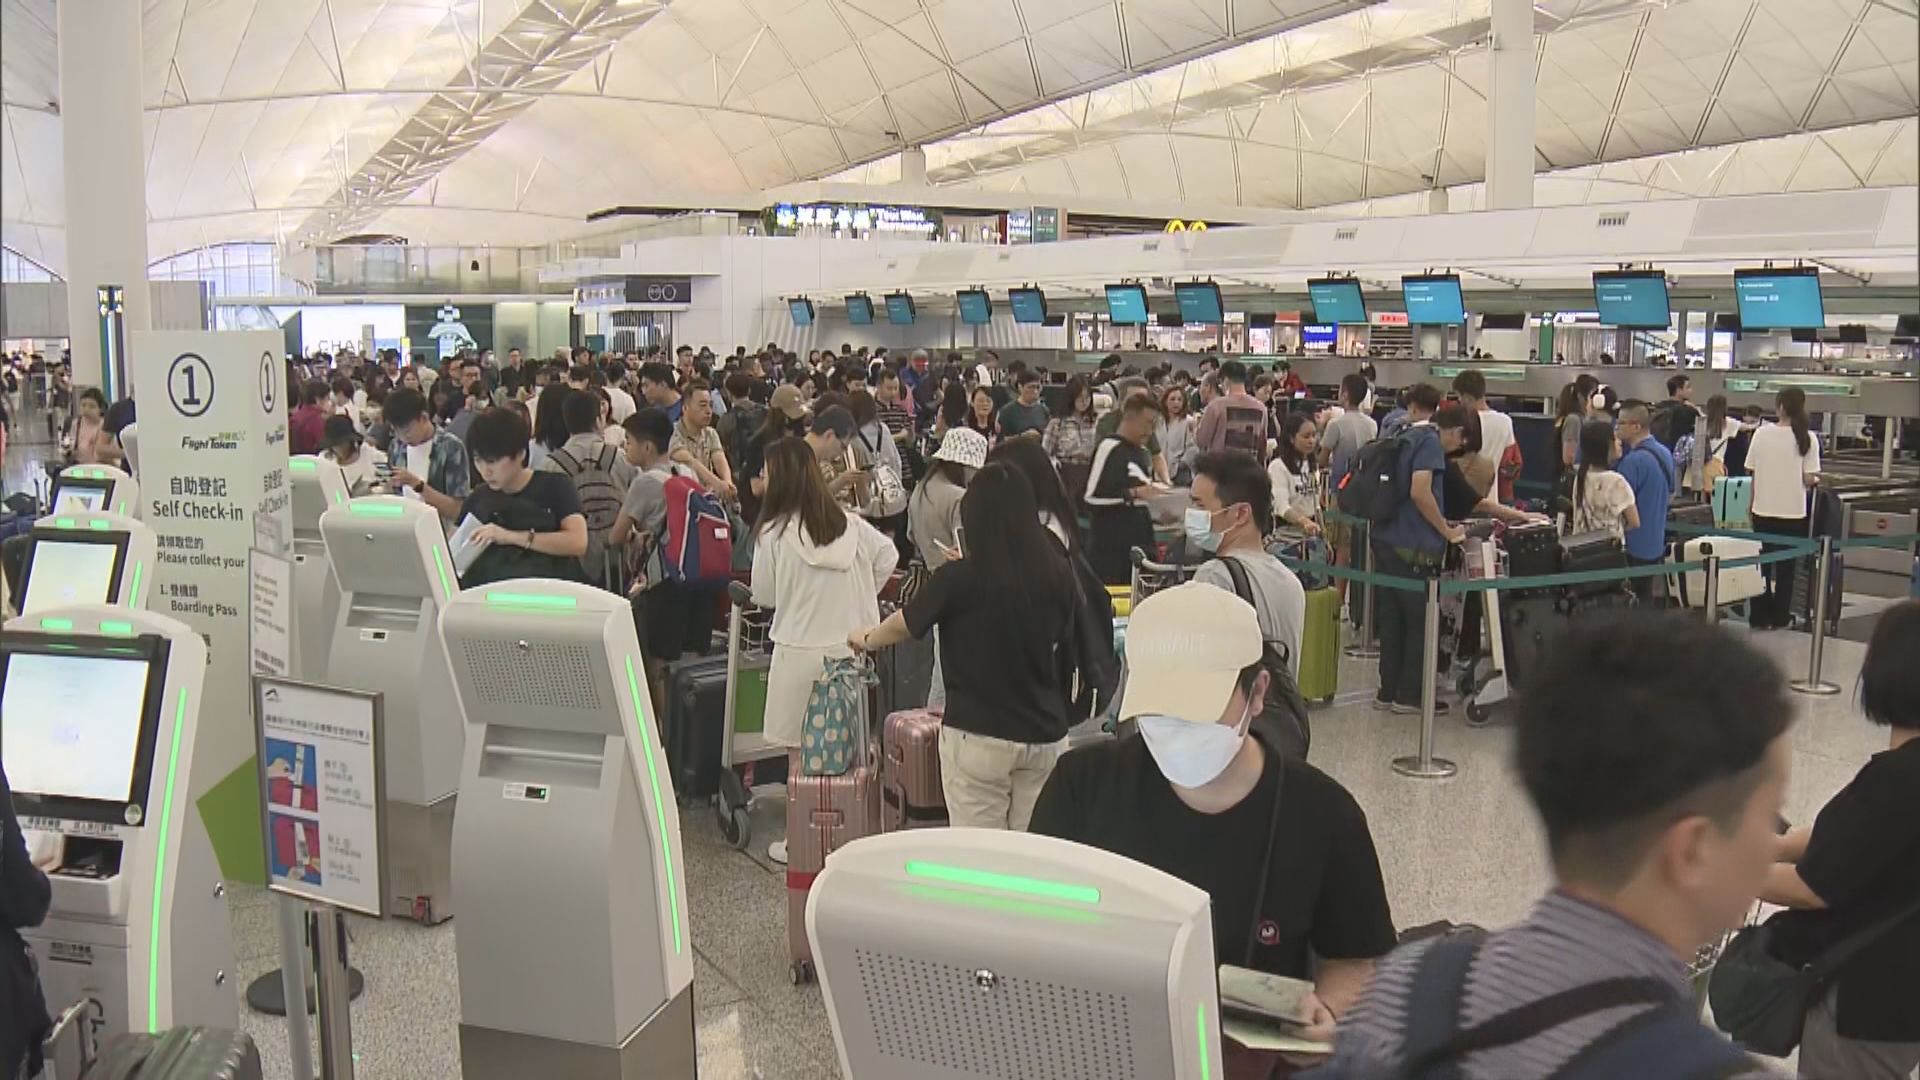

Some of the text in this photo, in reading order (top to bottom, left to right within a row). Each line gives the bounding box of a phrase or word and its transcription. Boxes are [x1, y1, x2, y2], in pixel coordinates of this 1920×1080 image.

[181, 365, 201, 405] 1
[209, 435, 237, 449] Token
[170, 476, 227, 497] 自助登記
[153, 500, 243, 521] Self Check-in
[157, 552, 245, 569] Please collect your
[171, 600, 238, 617] Boarding Pass
